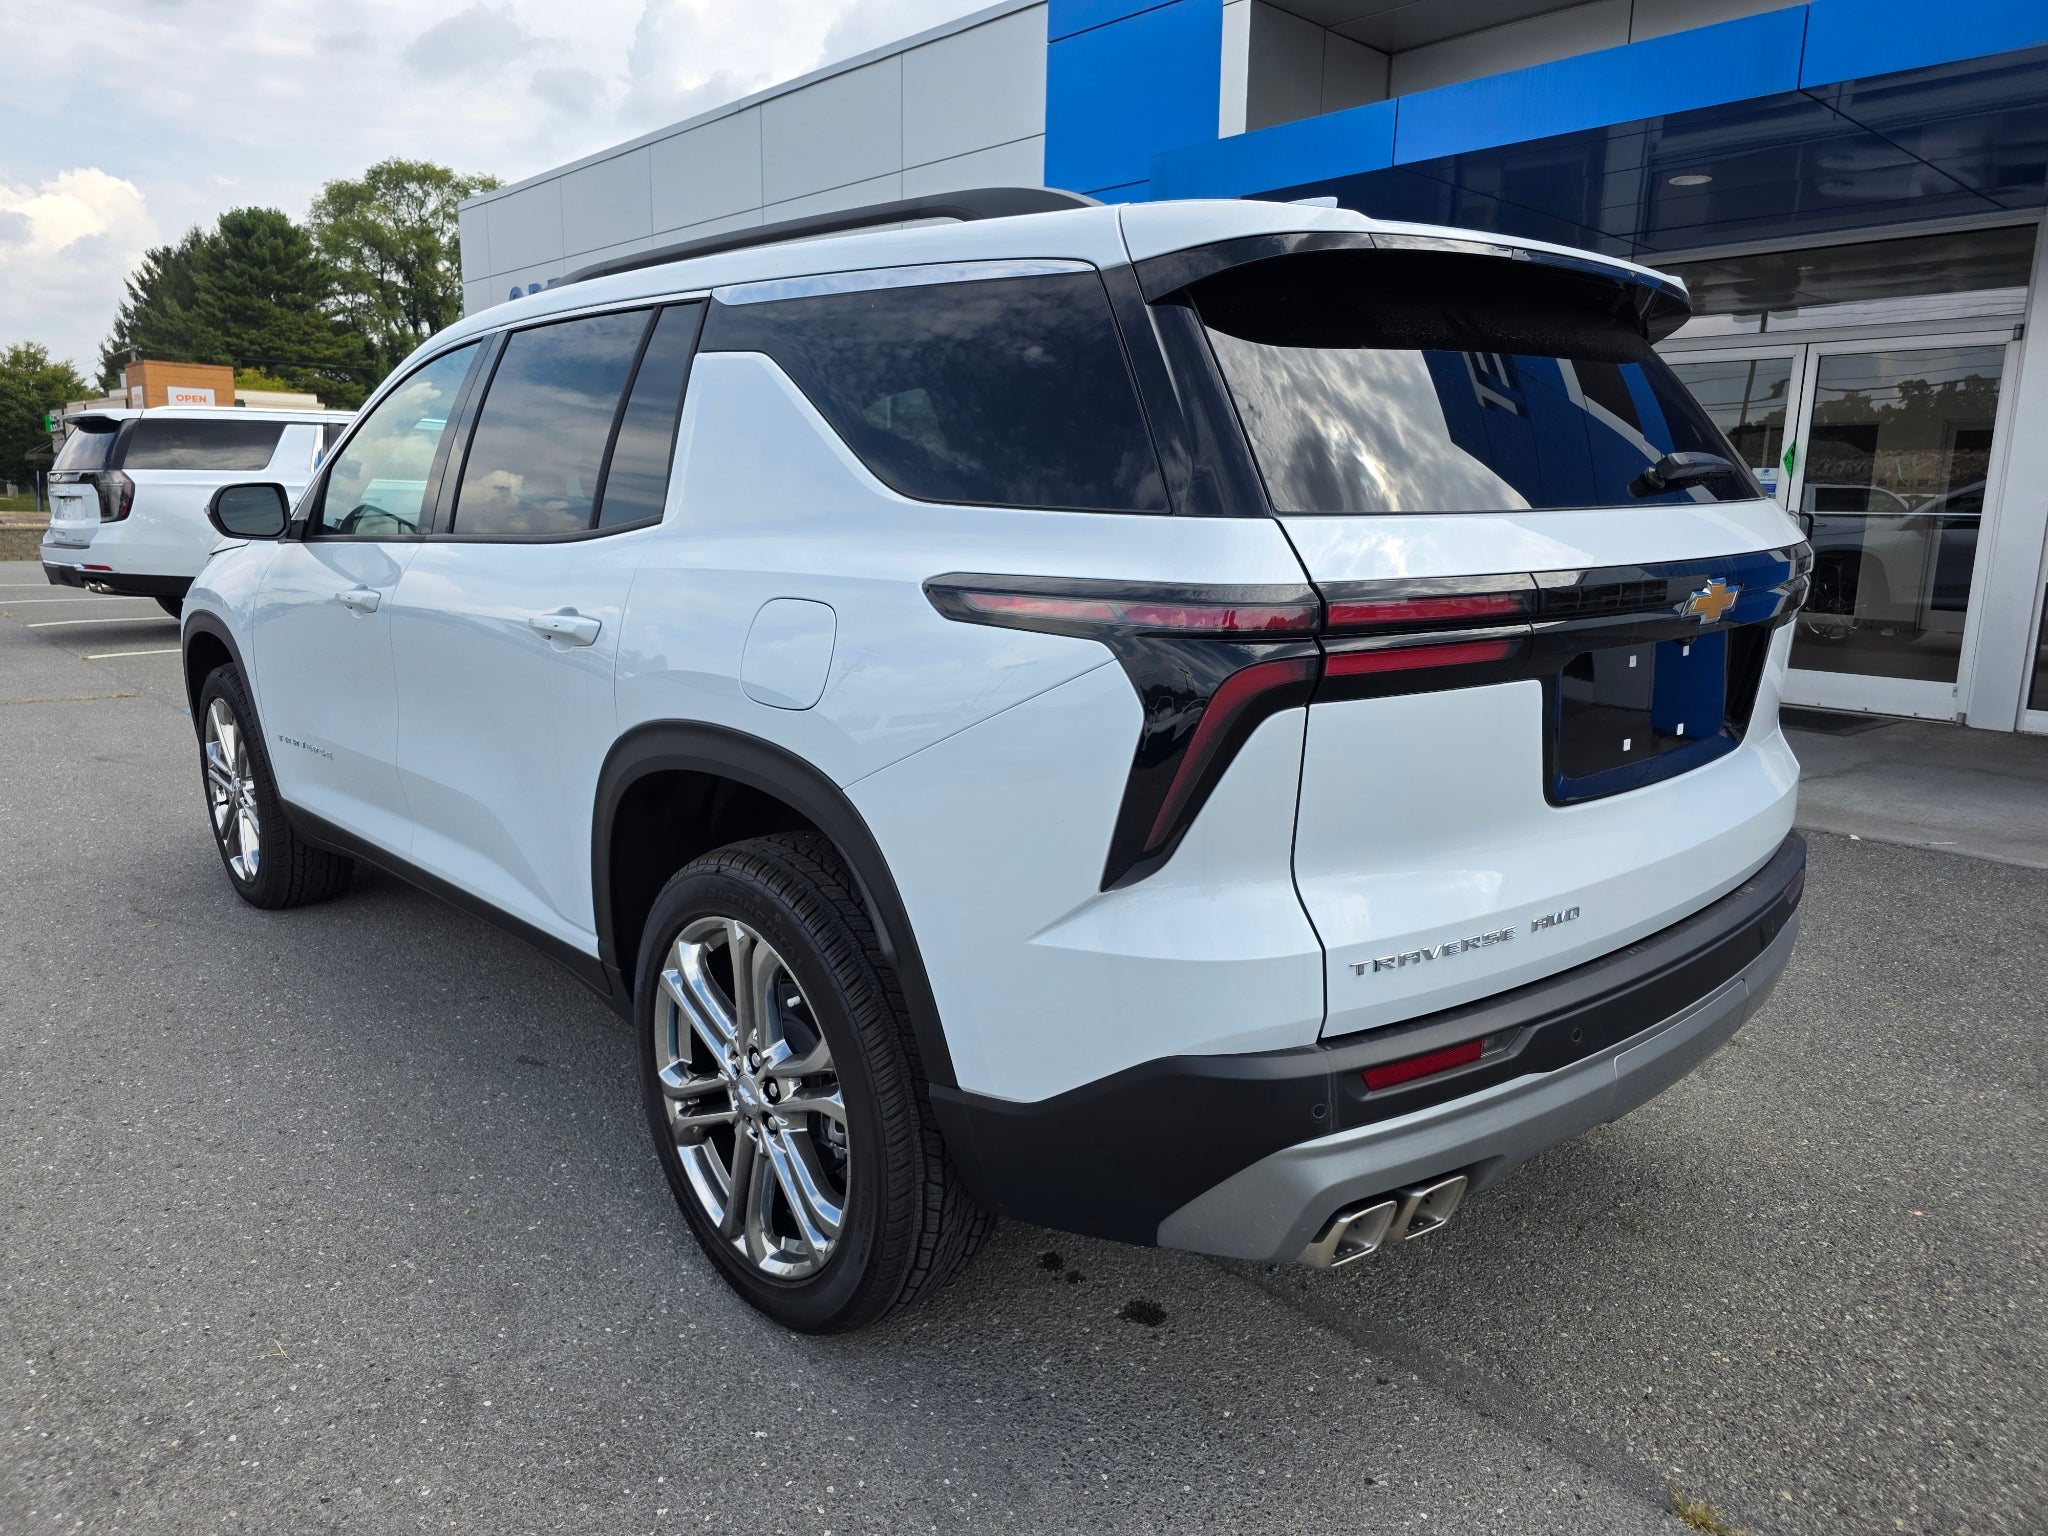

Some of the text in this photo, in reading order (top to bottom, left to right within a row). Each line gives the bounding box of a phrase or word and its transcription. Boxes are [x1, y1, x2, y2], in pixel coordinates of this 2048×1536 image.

[175, 393, 207, 403] OPEN
[1349, 906, 1580, 976] TRAVERSE AWD
